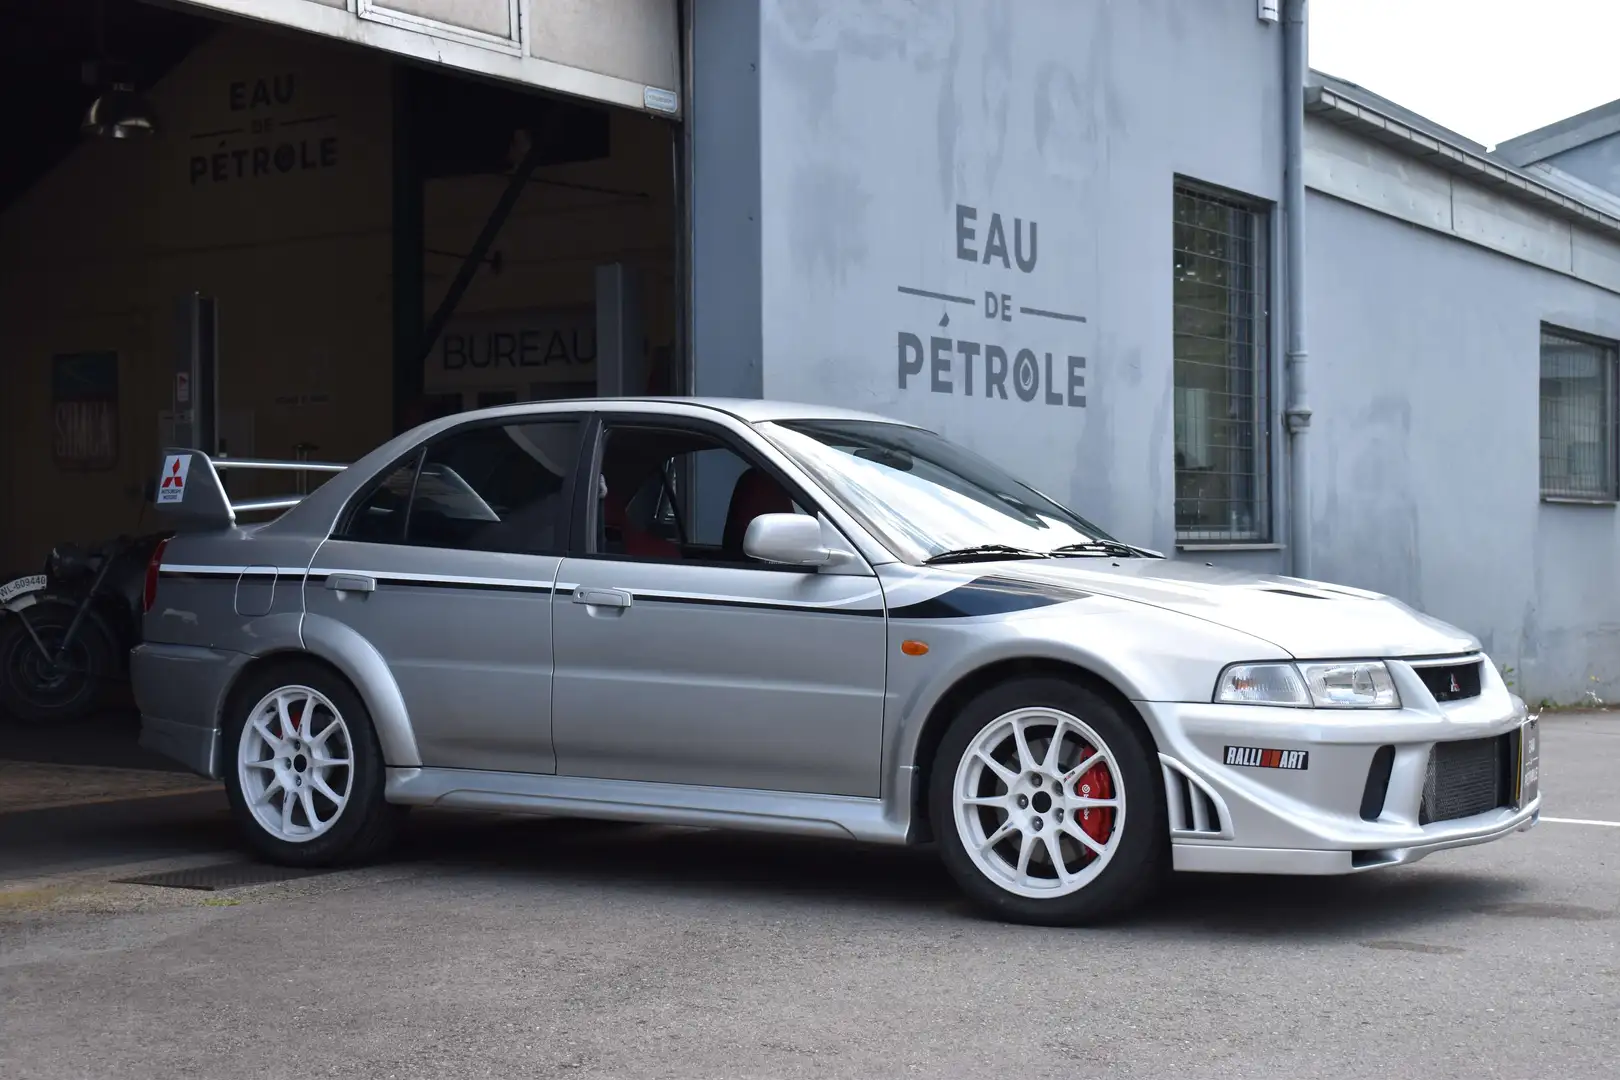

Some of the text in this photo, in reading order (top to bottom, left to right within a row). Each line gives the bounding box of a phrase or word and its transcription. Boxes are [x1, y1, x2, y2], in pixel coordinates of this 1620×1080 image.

[230, 73, 295, 111] EAU
[251, 118, 274, 134] DE
[190, 137, 338, 186] PÉTROLE
[956, 203, 1038, 274] EAU
[985, 291, 1013, 322] DE
[443, 328, 597, 370] BUREAU
[897, 312, 1087, 408] PÉTROLE
